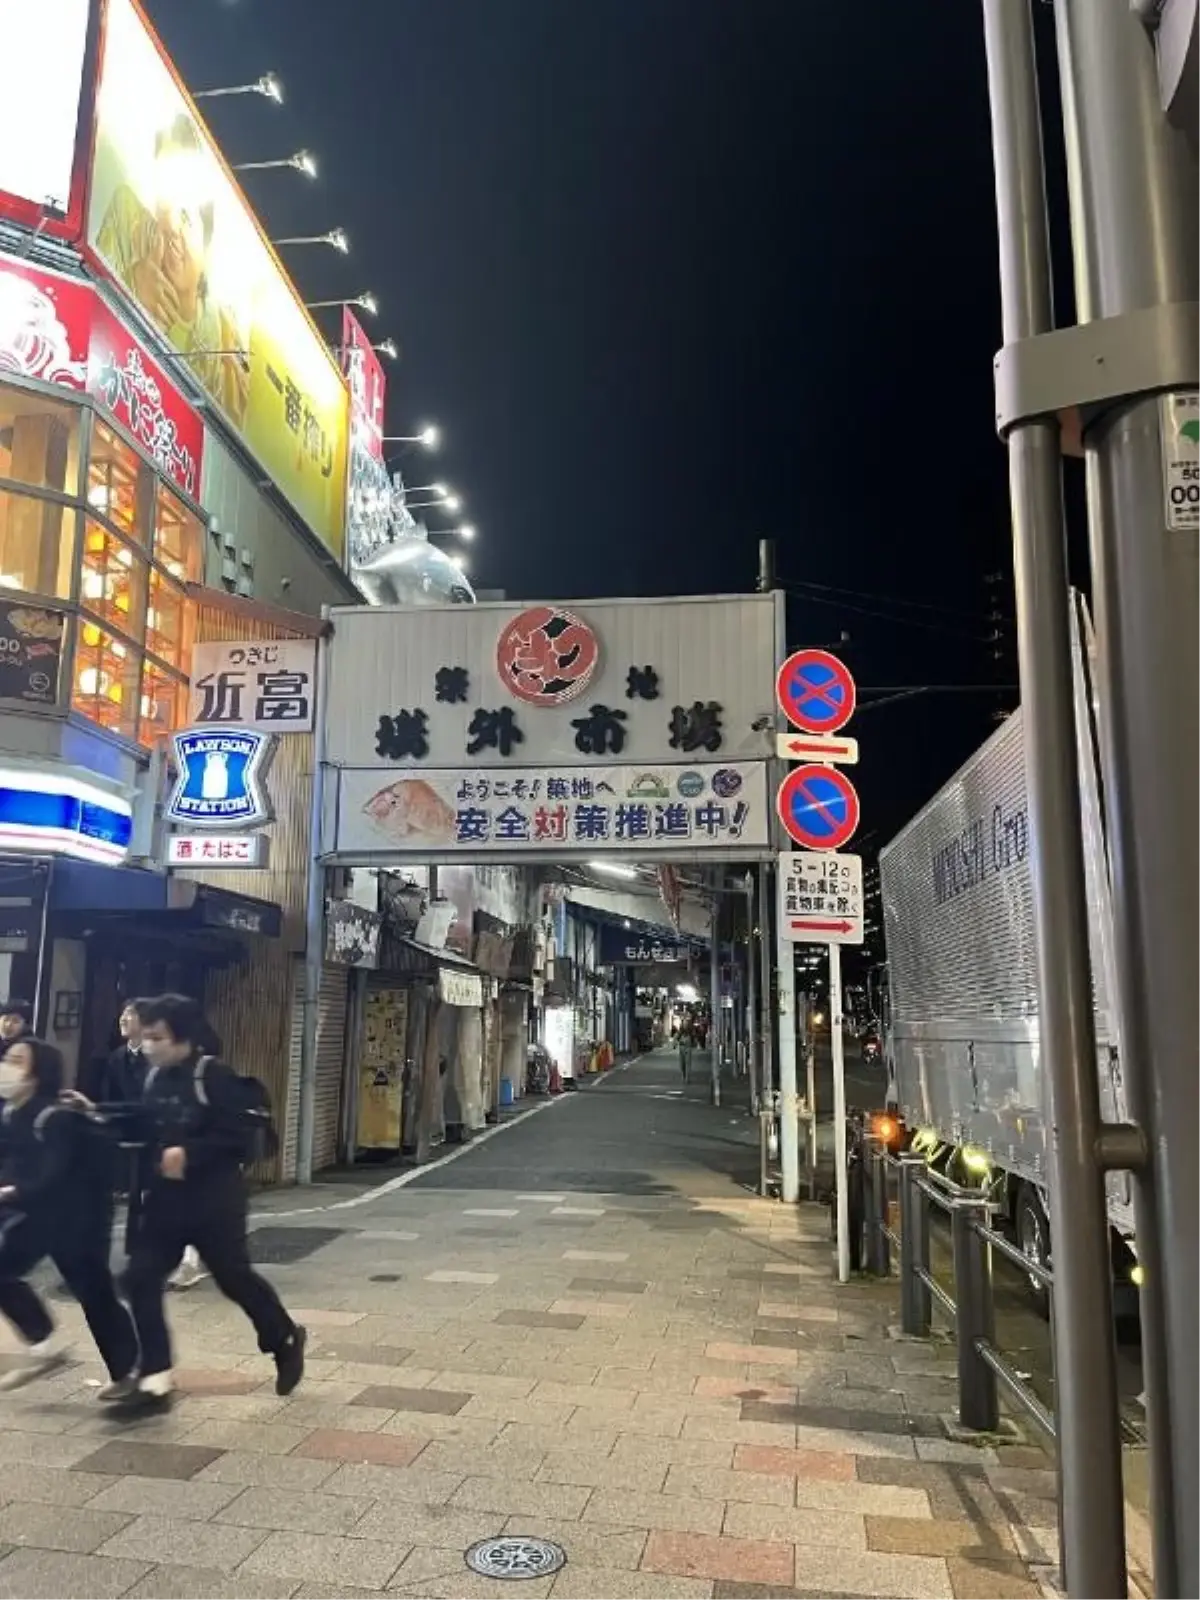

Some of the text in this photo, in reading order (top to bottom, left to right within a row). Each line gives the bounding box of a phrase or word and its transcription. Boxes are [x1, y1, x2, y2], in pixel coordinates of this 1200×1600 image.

[195, 669, 308, 722] 近富
[183, 739, 254, 755] LAWSON
[178, 797, 250, 812] STATION
